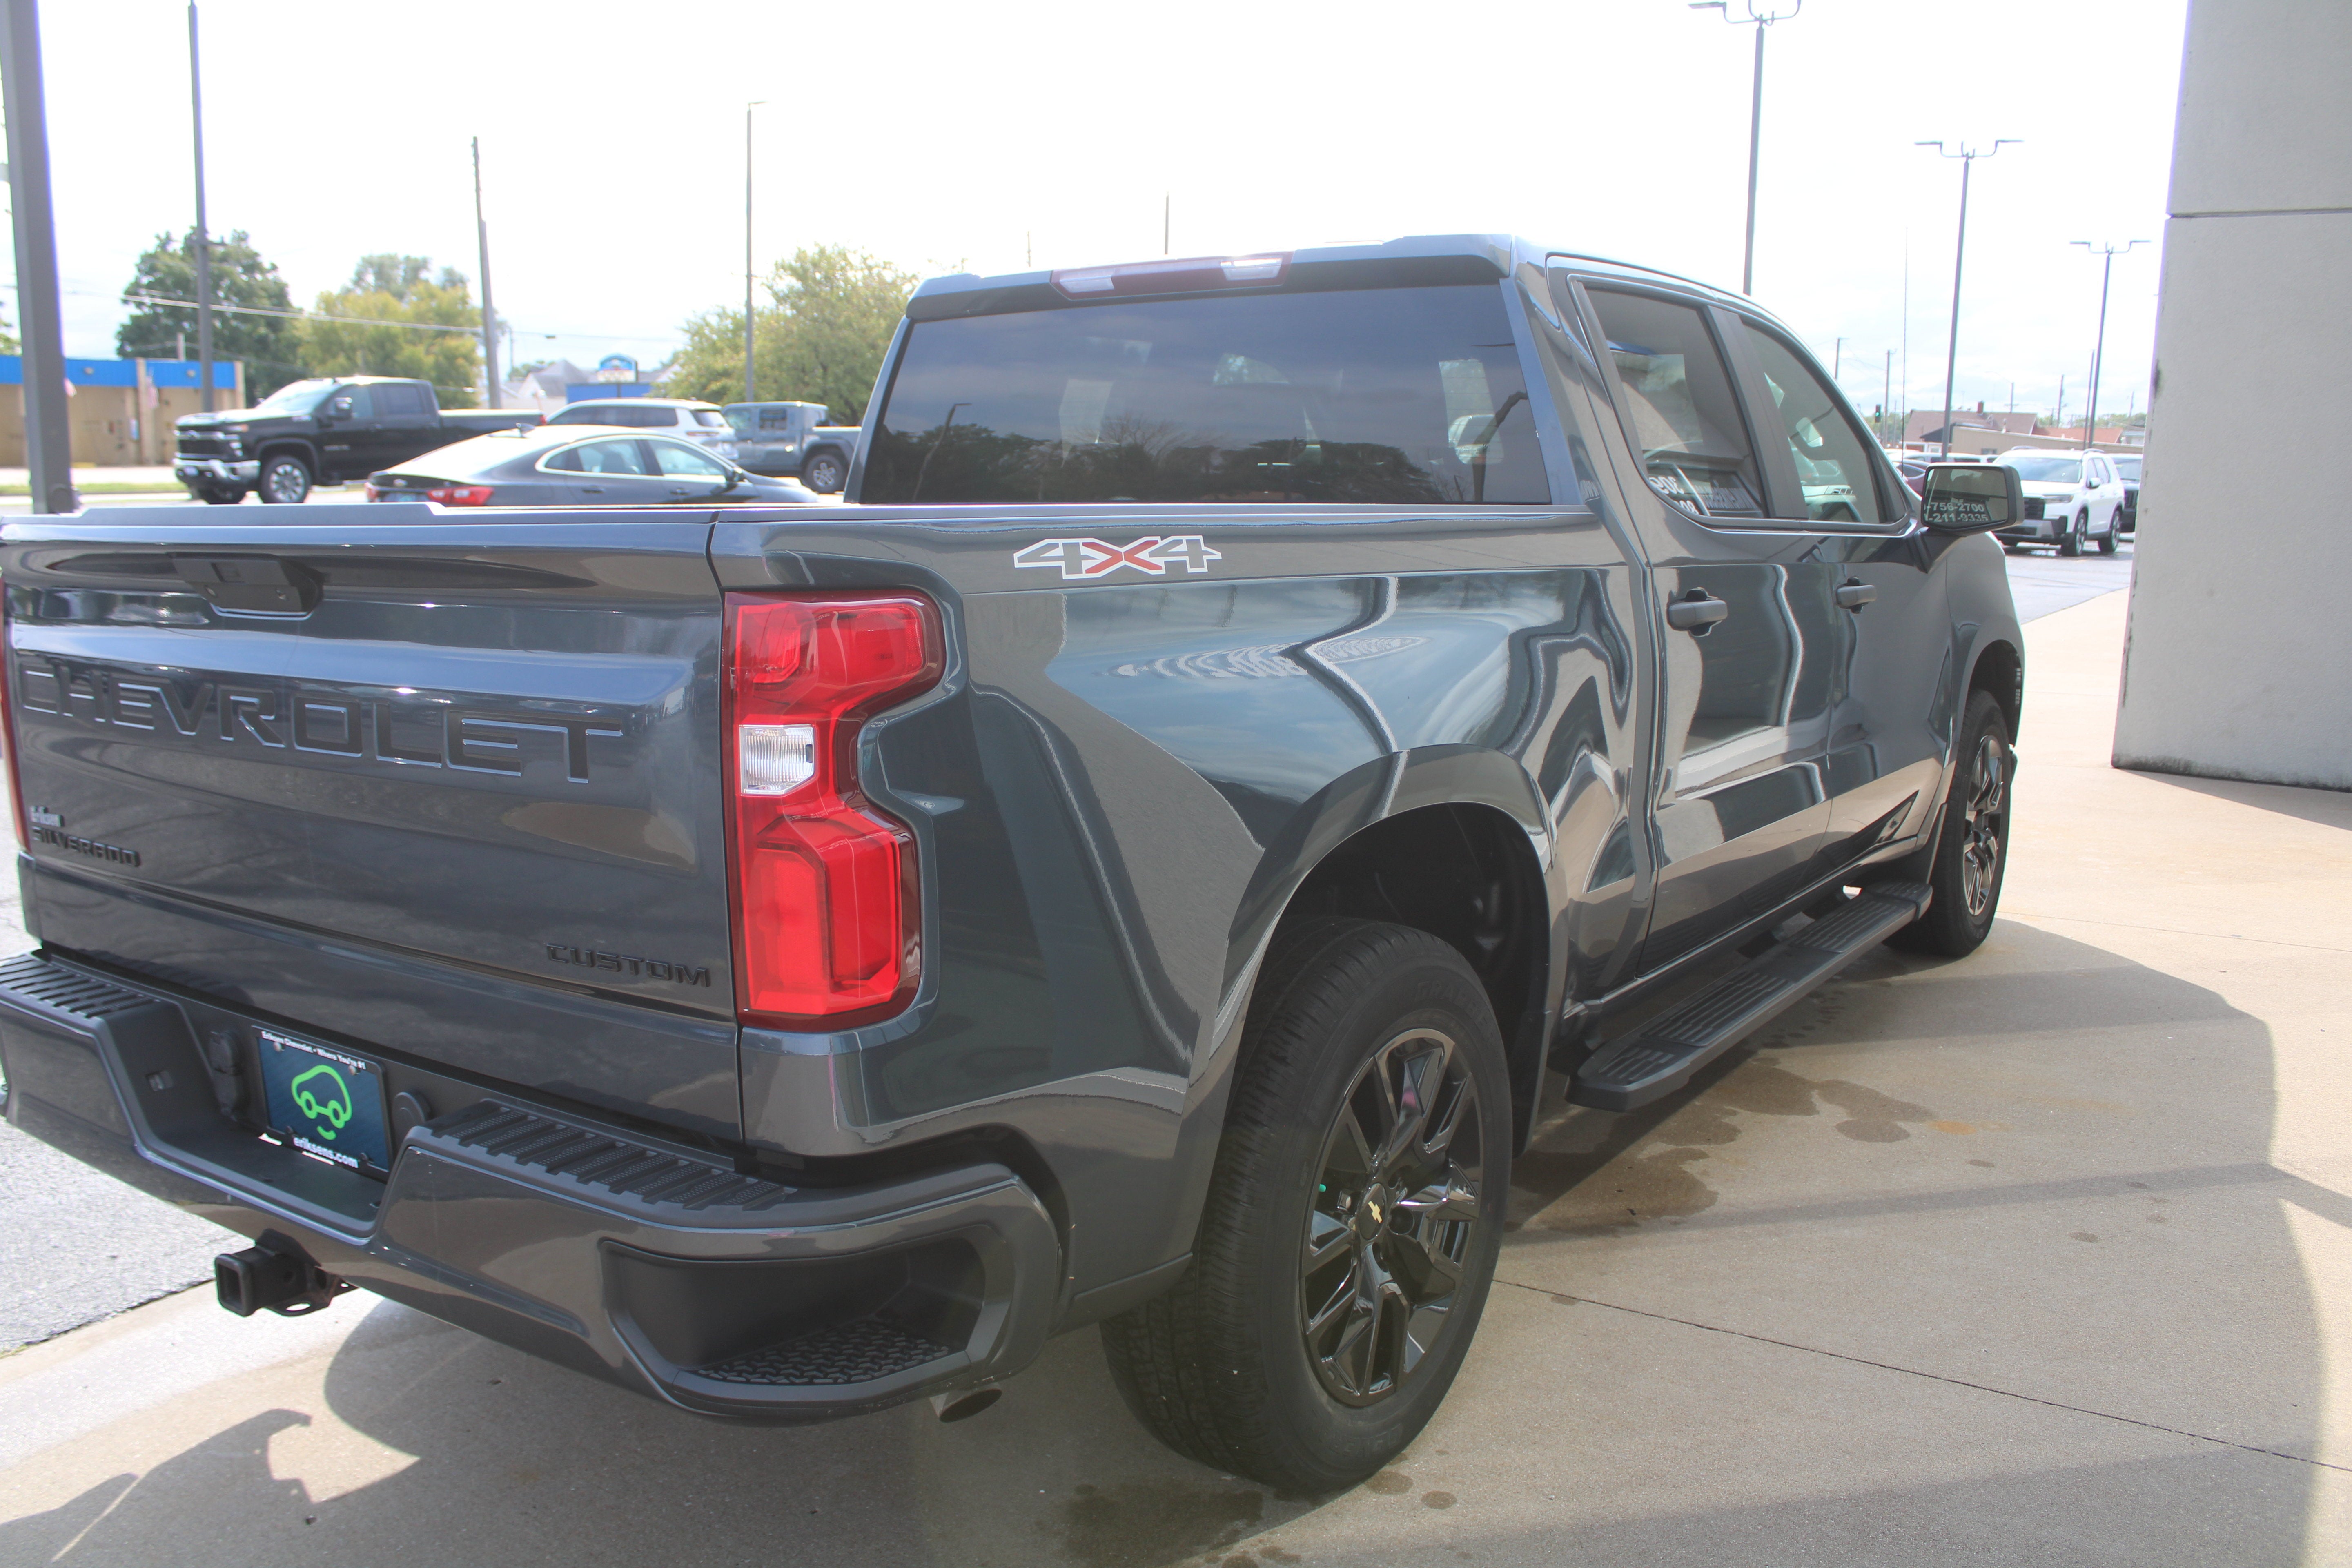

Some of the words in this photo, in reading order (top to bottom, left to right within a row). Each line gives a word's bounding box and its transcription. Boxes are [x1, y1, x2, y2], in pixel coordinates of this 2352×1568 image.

[1924, 502, 1984, 512] -756-2700
[20, 660, 624, 784] CHEVROLET
[32, 826, 141, 867] SILVERADO
[546, 943, 711, 987] CUSTOM
[284, 1038, 314, 1053] Chevrolet
[293, 1137, 359, 1169] eriksens.com
